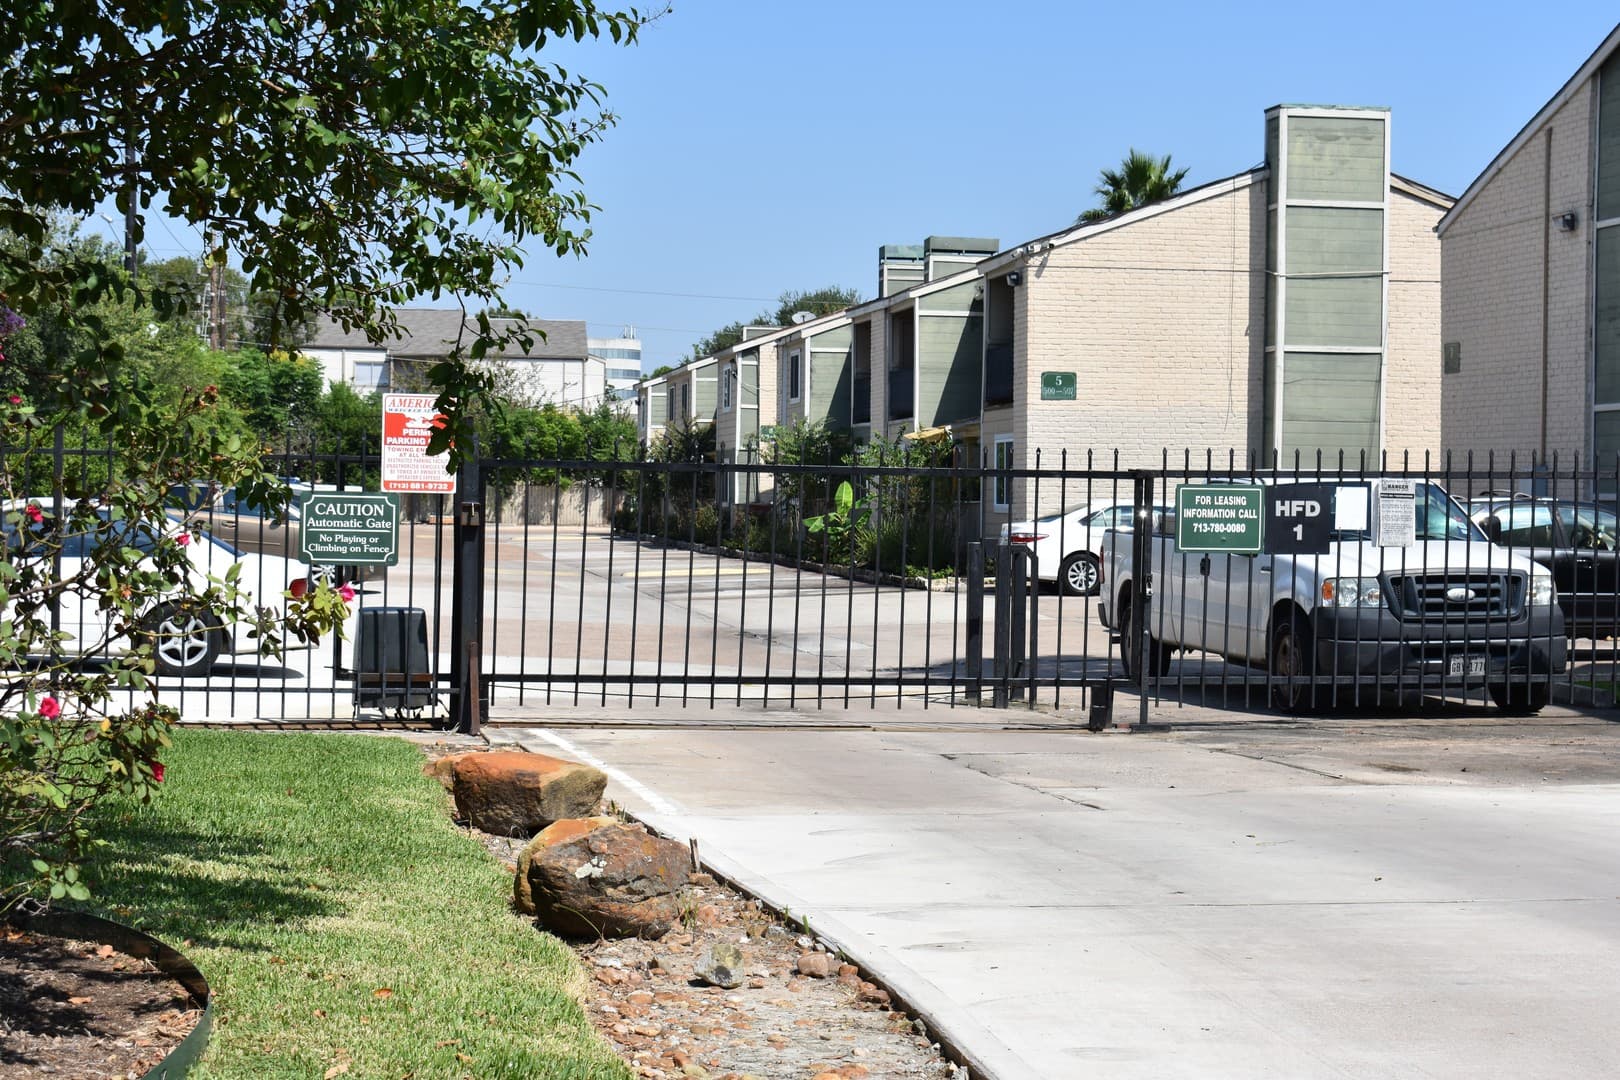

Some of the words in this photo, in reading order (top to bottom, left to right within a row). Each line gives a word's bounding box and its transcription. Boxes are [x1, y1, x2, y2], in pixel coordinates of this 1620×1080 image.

[1055, 375, 1063, 386] 5
[388, 397, 436, 408] AMERIC
[402, 428, 433, 436] PERMI
[386, 437, 426, 446] PARKING
[1195, 495, 1211, 505] FOR
[1214, 495, 1247, 506] LEASING
[315, 502, 384, 516] CAUTION
[1183, 508, 1236, 518] INFORMATION
[1238, 508, 1258, 519] CALL
[1275, 500, 1321, 518] HFD
[307, 517, 362, 528] Automatic
[366, 518, 392, 529] Gate
[1192, 522, 1246, 533] 713-780-0080
[1293, 524, 1304, 541] 1
[319, 533, 333, 543] No
[335, 534, 367, 545] Playing
[308, 543, 348, 554] Climbing
[363, 544, 390, 553] Fence
